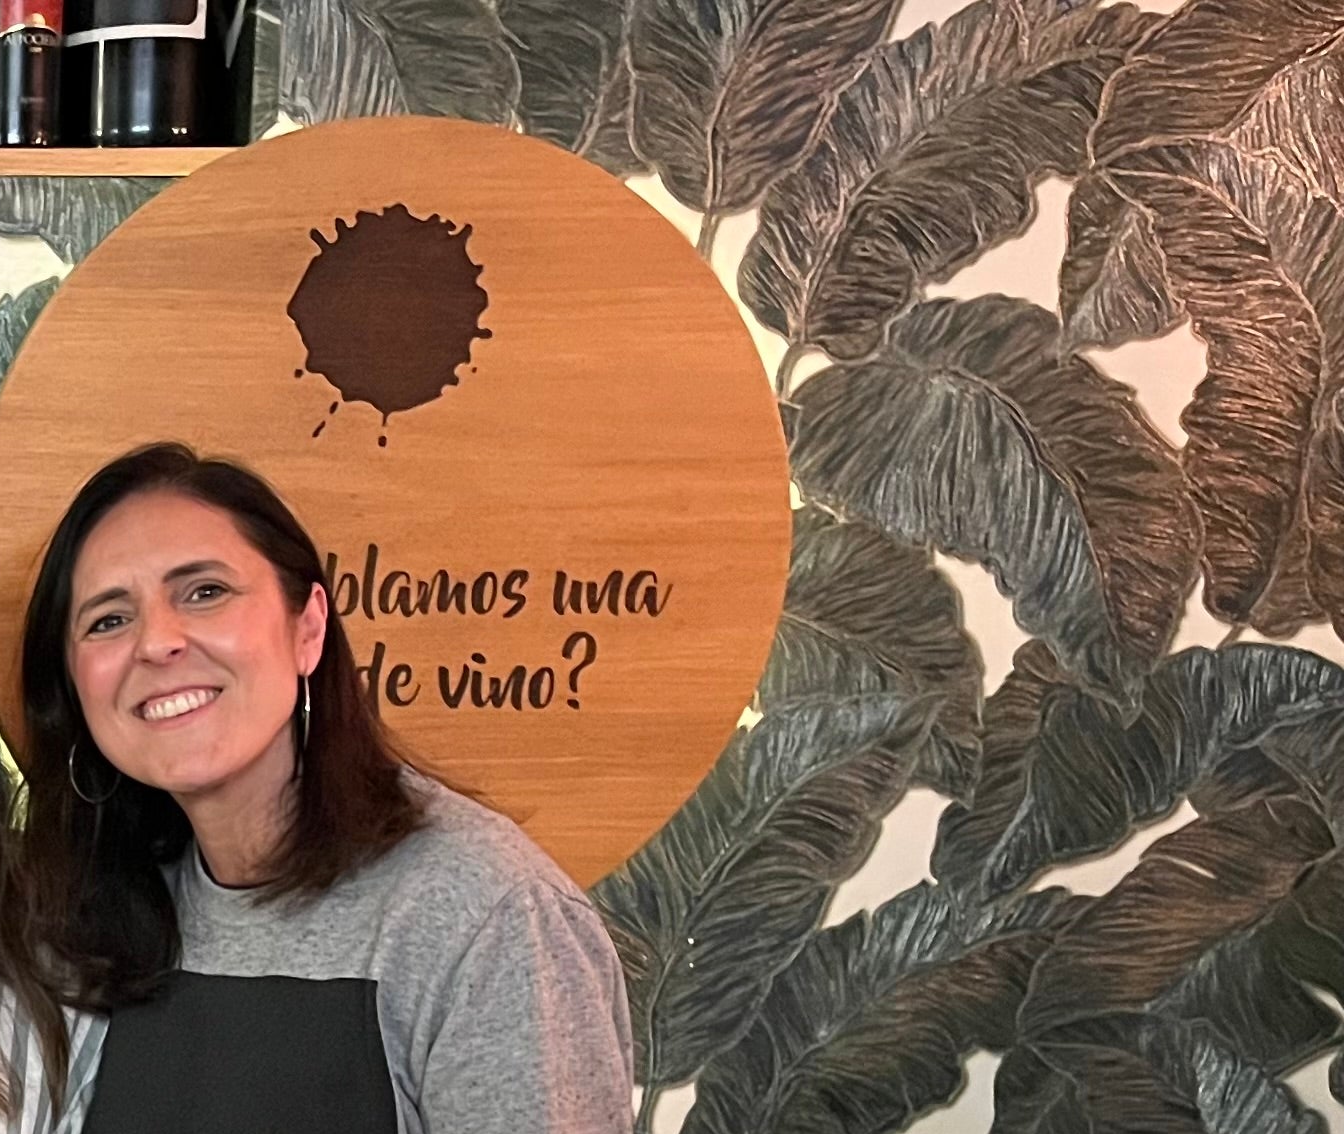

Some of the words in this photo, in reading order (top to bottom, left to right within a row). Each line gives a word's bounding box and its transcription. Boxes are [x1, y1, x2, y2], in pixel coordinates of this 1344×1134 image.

[553, 569, 674, 618] una
[356, 641, 421, 711] de
[438, 631, 598, 711] vino?
